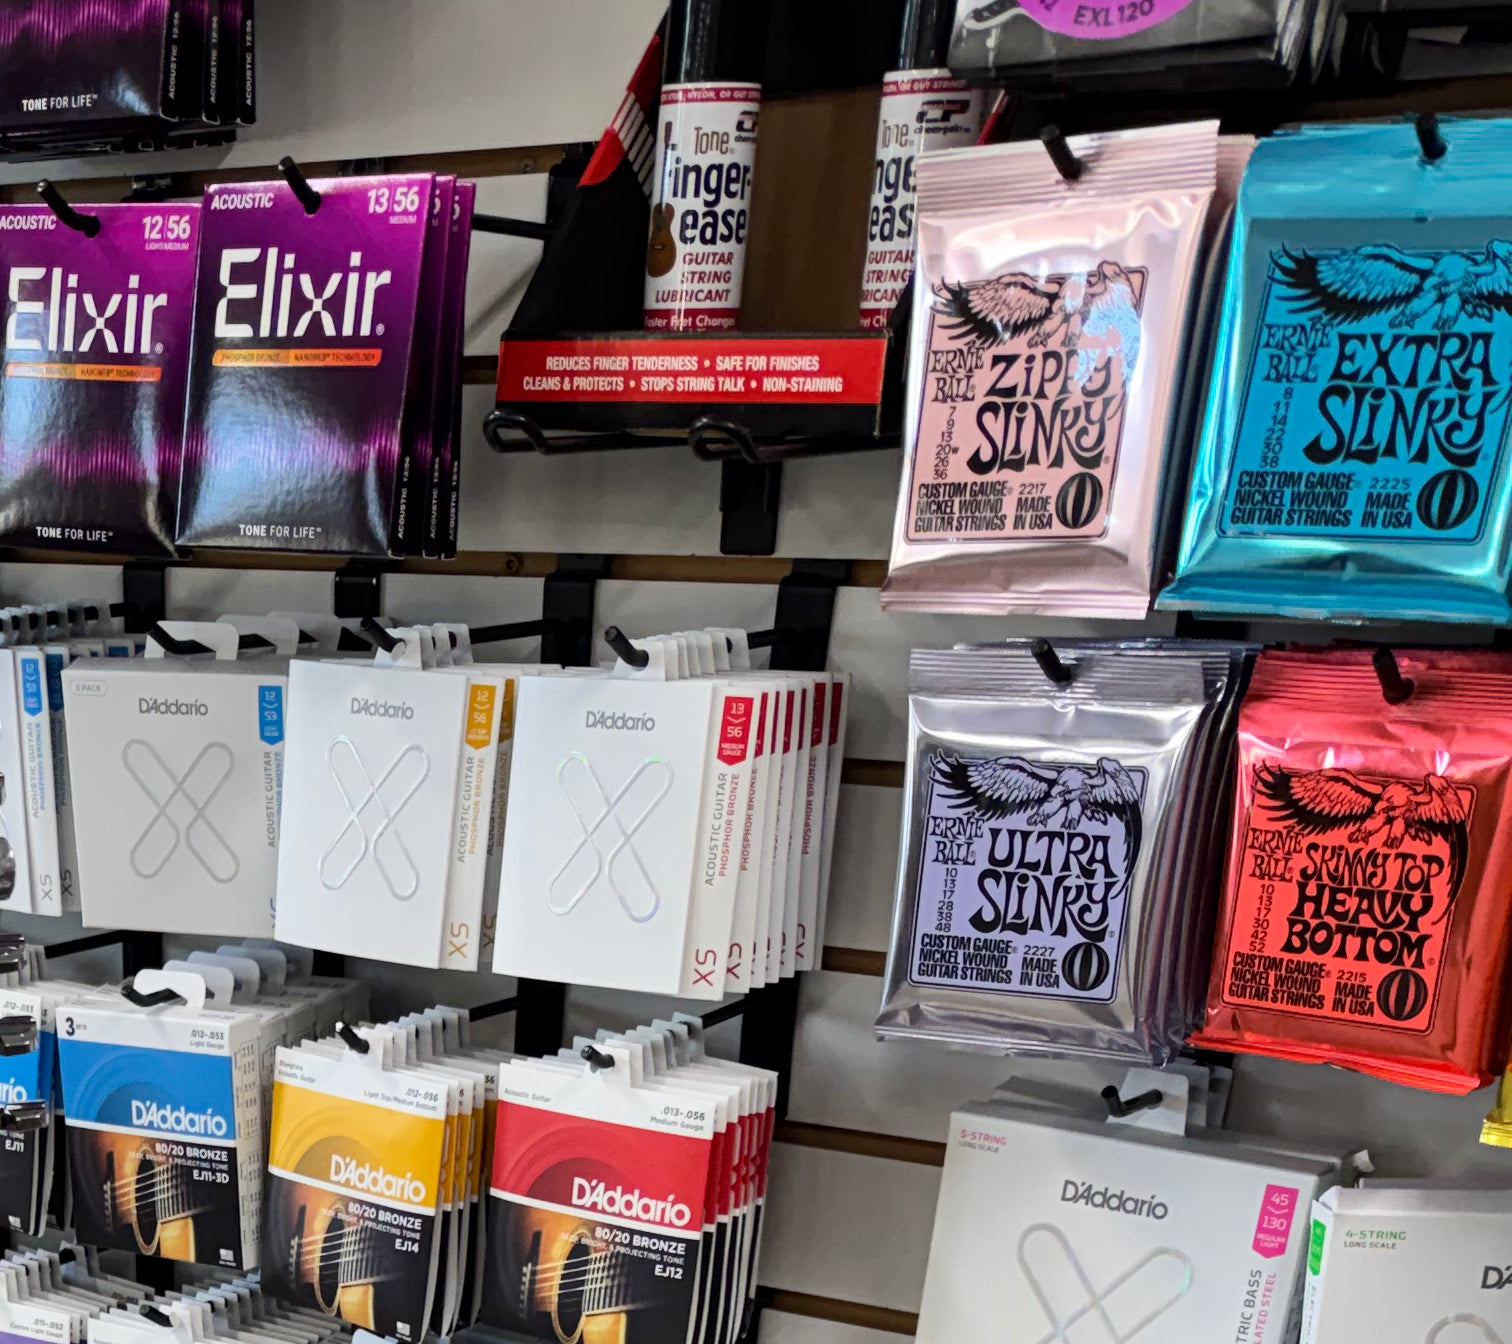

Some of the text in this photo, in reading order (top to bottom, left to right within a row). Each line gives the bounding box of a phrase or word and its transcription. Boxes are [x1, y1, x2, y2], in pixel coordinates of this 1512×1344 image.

[695, 127, 729, 155] Tone
[211, 192, 274, 209] ACOUSTIC
[680, 208, 746, 246] ease
[682, 252, 734, 265] GUITAR
[681, 270, 732, 283] STRING
[655, 289, 730, 302] LUBRICANT
[546, 356, 819, 370] REDUCES FINGER TENDERNESS SAFE FOR FINISHES
[929, 343, 986, 374] ERNIE
[1333, 333, 1494, 389] EXTRA
[523, 377, 842, 392] CLEANS & PROTECTS STOPS STRING TALK NON-STAINING
[932, 375, 976, 403] BALL
[967, 397, 1122, 475] SLINKY
[1303, 385, 1487, 466] SLINKY
[918, 481, 1046, 498] CUSTOM GAUGE 2217
[916, 498, 1051, 515] NICKEL WOUND MADE
[239, 524, 266, 536] TONE
[270, 525, 289, 537] FOR
[915, 514, 1052, 531] GUITAR STRINGS IN USA
[138, 698, 209, 718] D'Addario
[350, 698, 414, 722] D'Addario
[585, 712, 656, 733] D'Addario
[929, 812, 986, 842] ERNIE
[936, 839, 975, 865] BALL
[1249, 826, 1303, 855] ERNIE
[989, 828, 1114, 879] ULTRA
[1251, 855, 1293, 880] BALL
[1300, 843, 1444, 893] SKINNY TOP
[969, 868, 1123, 942] SLINKY
[1293, 884, 1435, 930] HEAVY
[1284, 920, 1431, 968] BOTTOM
[692, 949, 719, 986] XS
[132, 1099, 227, 1137] D'Addario
[961, 1129, 1007, 1146] 5-STRING
[192, 1170, 230, 1184] EJ11-3D
[330, 1155, 426, 1202] D'Addario
[571, 1177, 690, 1226] D'Addario
[1062, 1180, 1169, 1220] D'Addario
[1270, 1193, 1289, 1206] 45
[1262, 1216, 1287, 1231] 130
[1345, 1229, 1406, 1240] 4-STRING
[394, 1239, 420, 1253] EJ14
[594, 1227, 686, 1254] 80/20 BRONZE
[1344, 1240, 1397, 1250] LONG SCALE
[654, 1264, 683, 1279] EJ12
[1243, 1269, 1262, 1308] BASS
